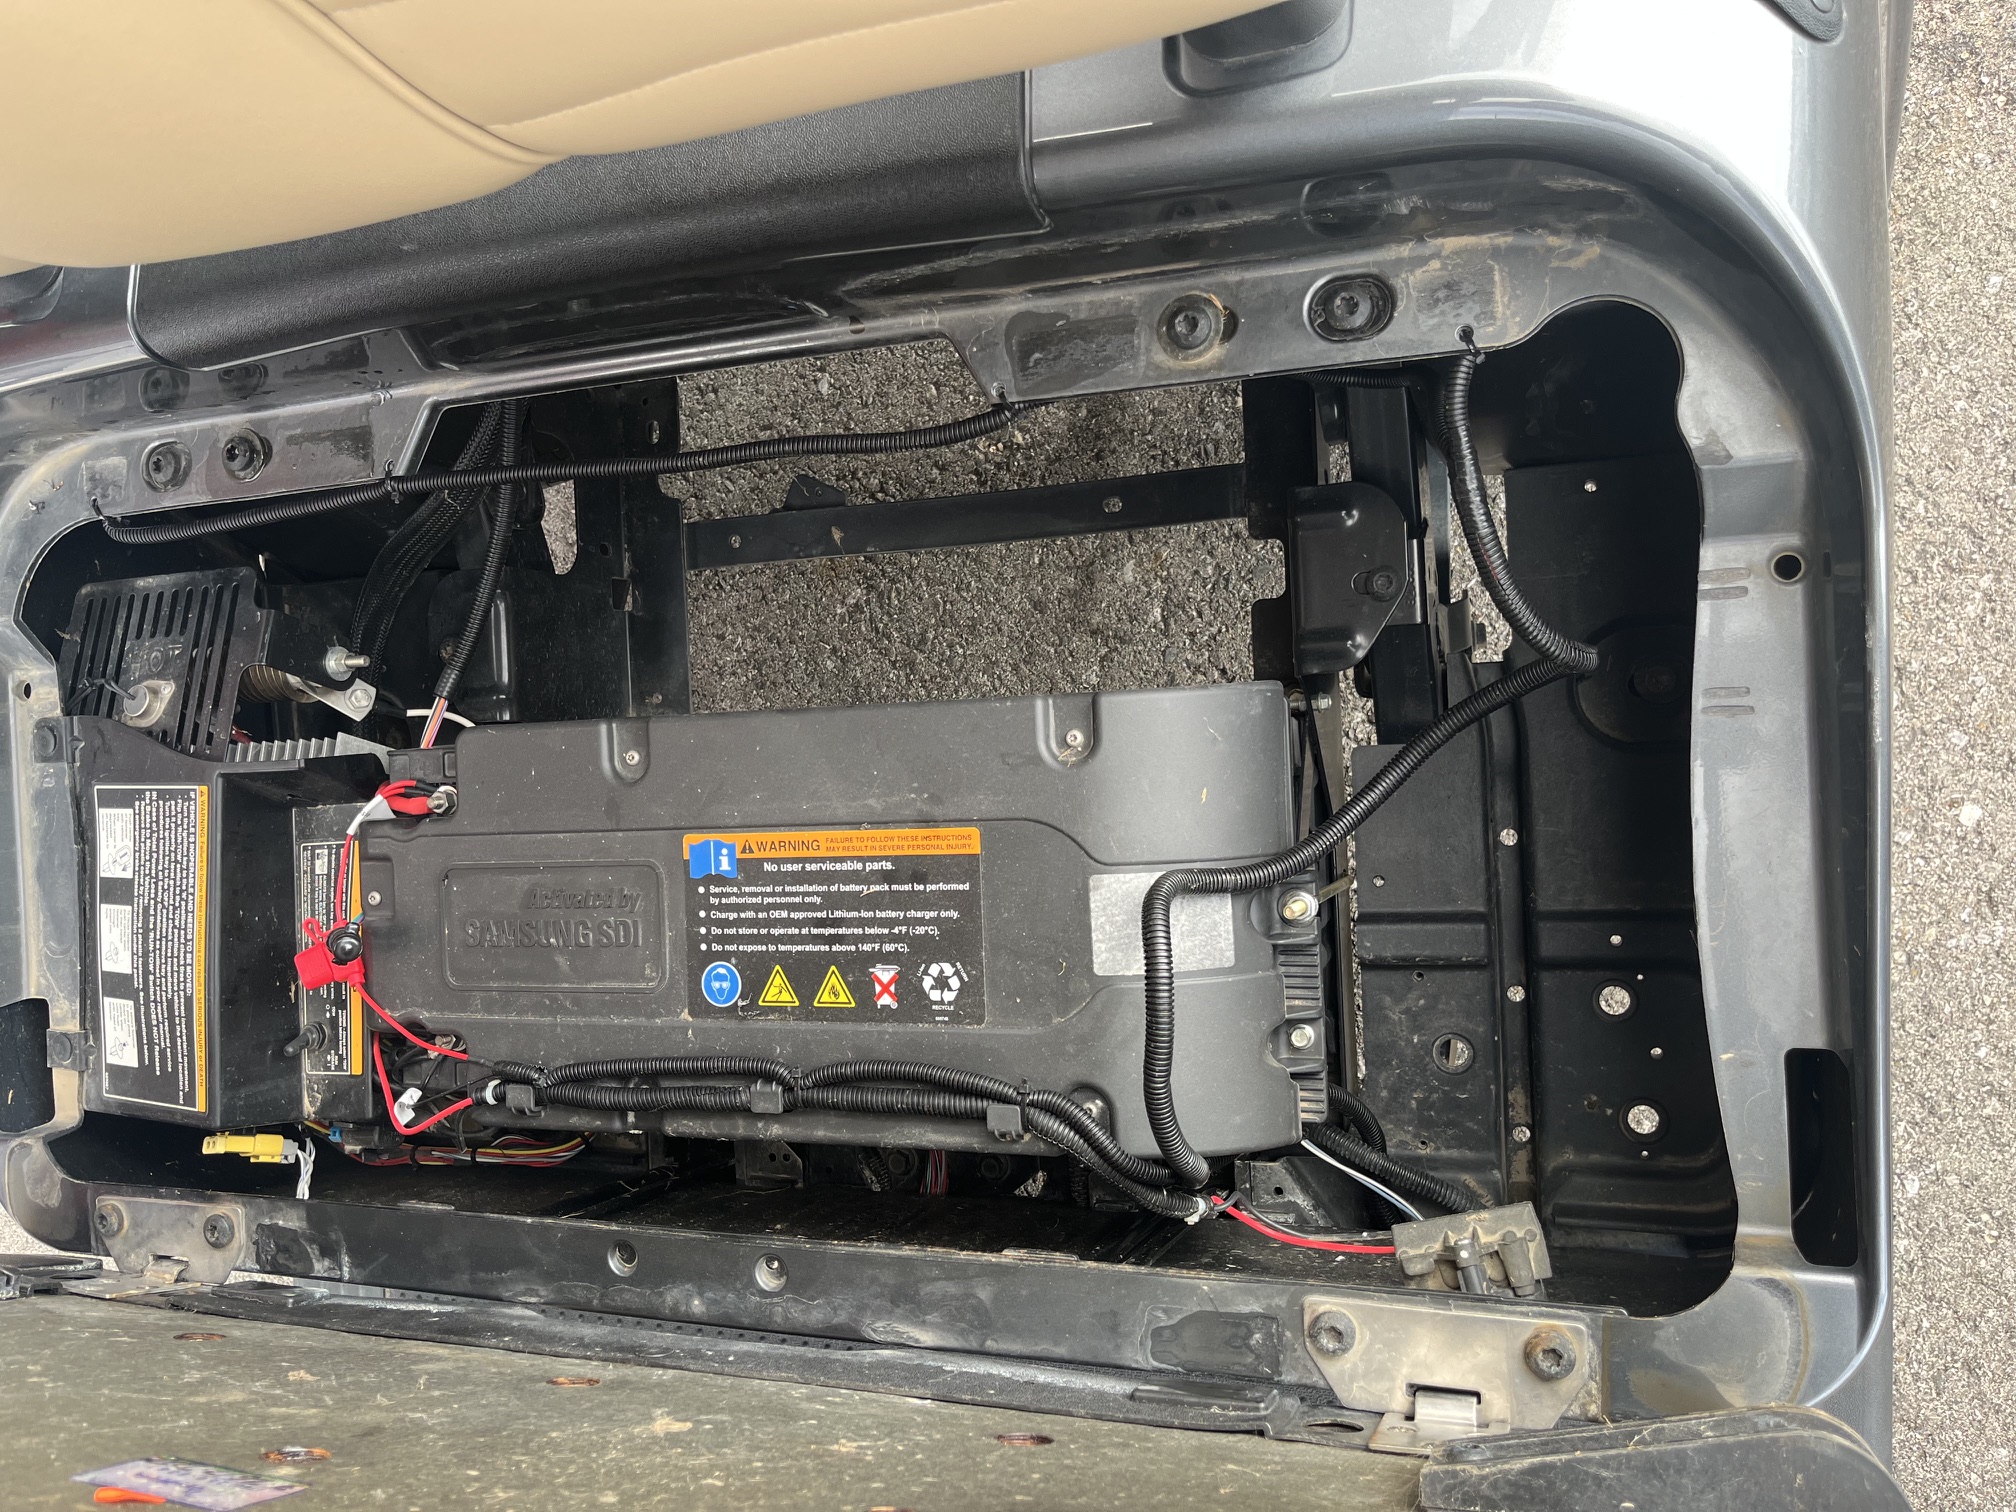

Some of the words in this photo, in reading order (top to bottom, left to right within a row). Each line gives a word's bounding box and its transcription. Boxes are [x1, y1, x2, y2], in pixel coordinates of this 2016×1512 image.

[826, 836, 852, 844] FAILURE
[756, 840, 820, 852] WARNING
[764, 862, 778, 871] No
[780, 863, 802, 871] user
[805, 860, 862, 871] serviceable
[866, 860, 895, 872] parts.
[710, 885, 740, 894] Service,
[785, 884, 828, 892] installation
[830, 884, 838, 892] of
[840, 884, 867, 892] battery
[870, 883, 889, 892] pack
[926, 883, 969, 892] performed
[528, 888, 614, 909] Activated
[619, 887, 642, 913] by
[710, 896, 719, 905] by
[764, 895, 802, 905] personnel
[804, 895, 822, 904] only.
[710, 911, 738, 920] Charge
[769, 910, 788, 918] OEM
[790, 910, 826, 919] approved
[876, 910, 904, 919] battery
[906, 910, 938, 919] charger
[940, 910, 960, 919] only.
[465, 919, 593, 948] SAMSUNG
[600, 919, 642, 948] SDI
[770, 927, 799, 936] operate
[810, 927, 863, 936] temperatures
[187, 941, 192, 951] TO
[778, 944, 829, 952] temperatures
[882, 944, 909, 953] (60°C).
[187, 954, 192, 964] BE
